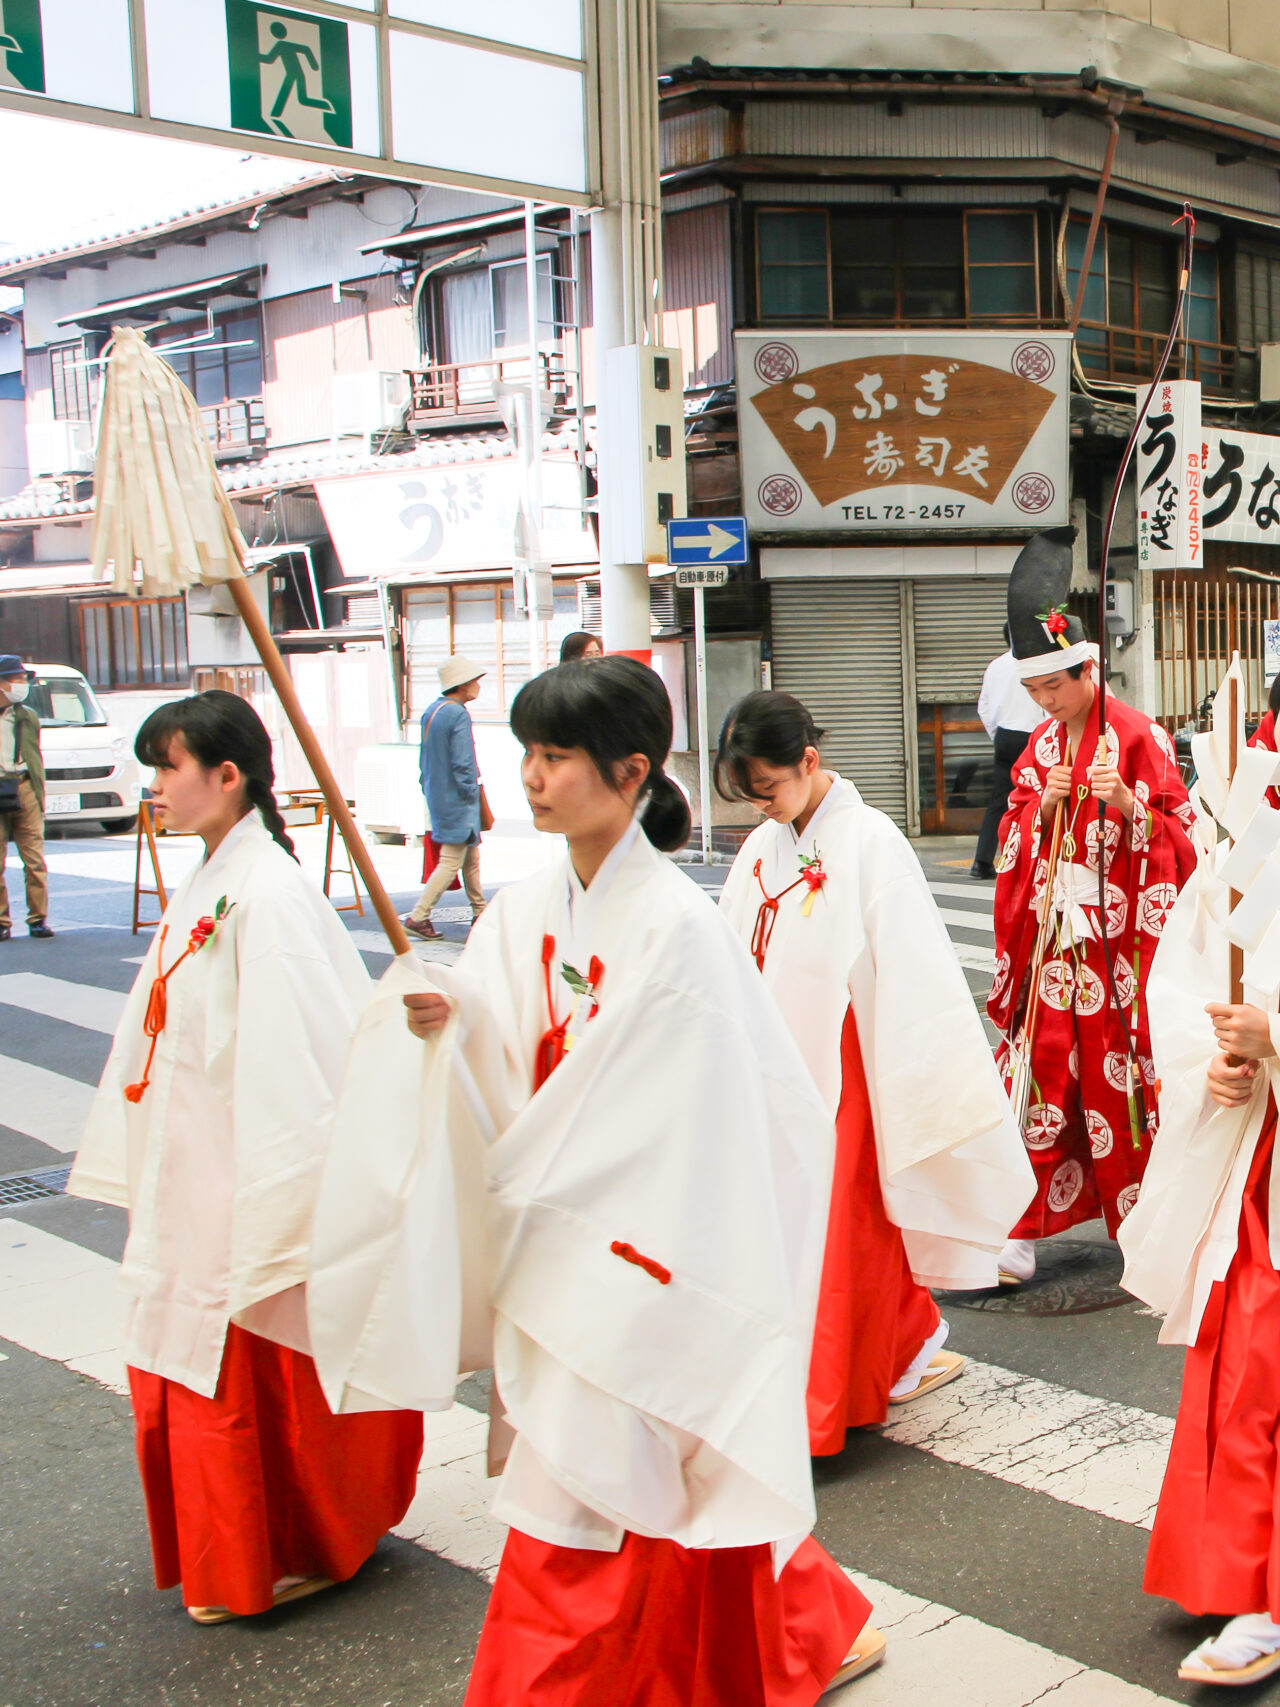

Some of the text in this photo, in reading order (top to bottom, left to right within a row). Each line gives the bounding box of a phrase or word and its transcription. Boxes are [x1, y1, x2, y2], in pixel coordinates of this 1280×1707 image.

[1162, 386, 1172, 413] 炭焼
[1140, 413, 1179, 550] うなぎ
[842, 504, 966, 521] TEL 72-2457
[1140, 521, 1149, 561] 専門店
